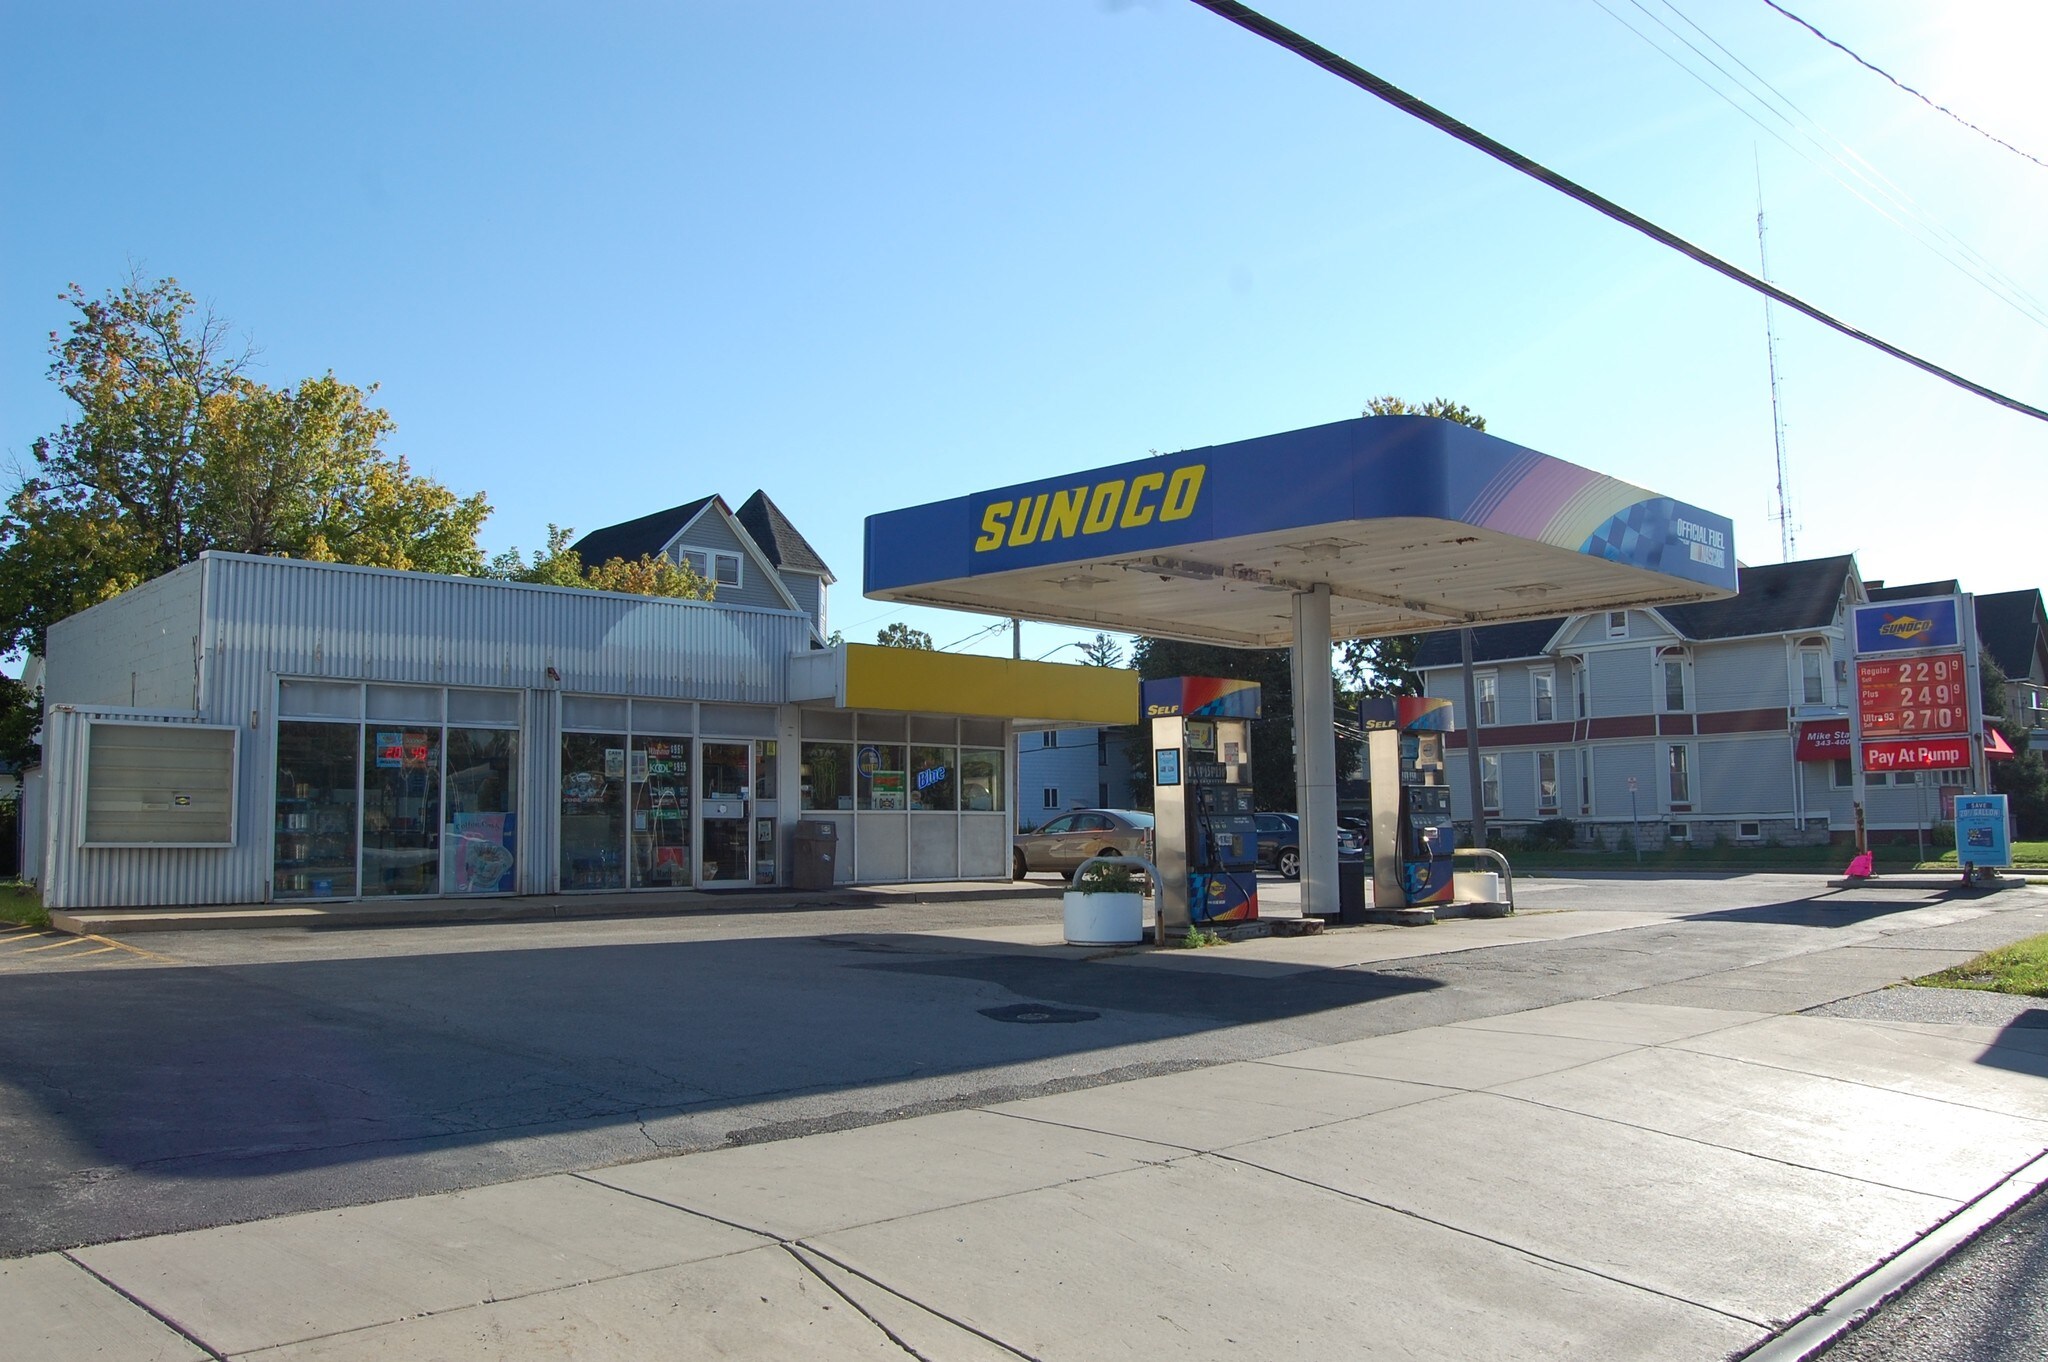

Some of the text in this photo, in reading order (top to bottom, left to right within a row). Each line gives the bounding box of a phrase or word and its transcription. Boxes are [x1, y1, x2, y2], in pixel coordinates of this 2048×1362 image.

[974, 464, 1206, 552] SUNOCO
[1677, 518, 1725, 549] OFFICIAL FUEL
[1881, 620, 1930, 634] SUNOCO
[1861, 667, 1890, 677] Regular
[1862, 690, 1879, 698] Plus
[1863, 713, 1883, 722] Ultra
[1884, 713, 1894, 721] 93
[1807, 732, 1831, 741] Mike
[1869, 748, 1959, 766] Pay At Pump
[649, 763, 671, 773] KOOL
[917, 766, 945, 790] Blue
